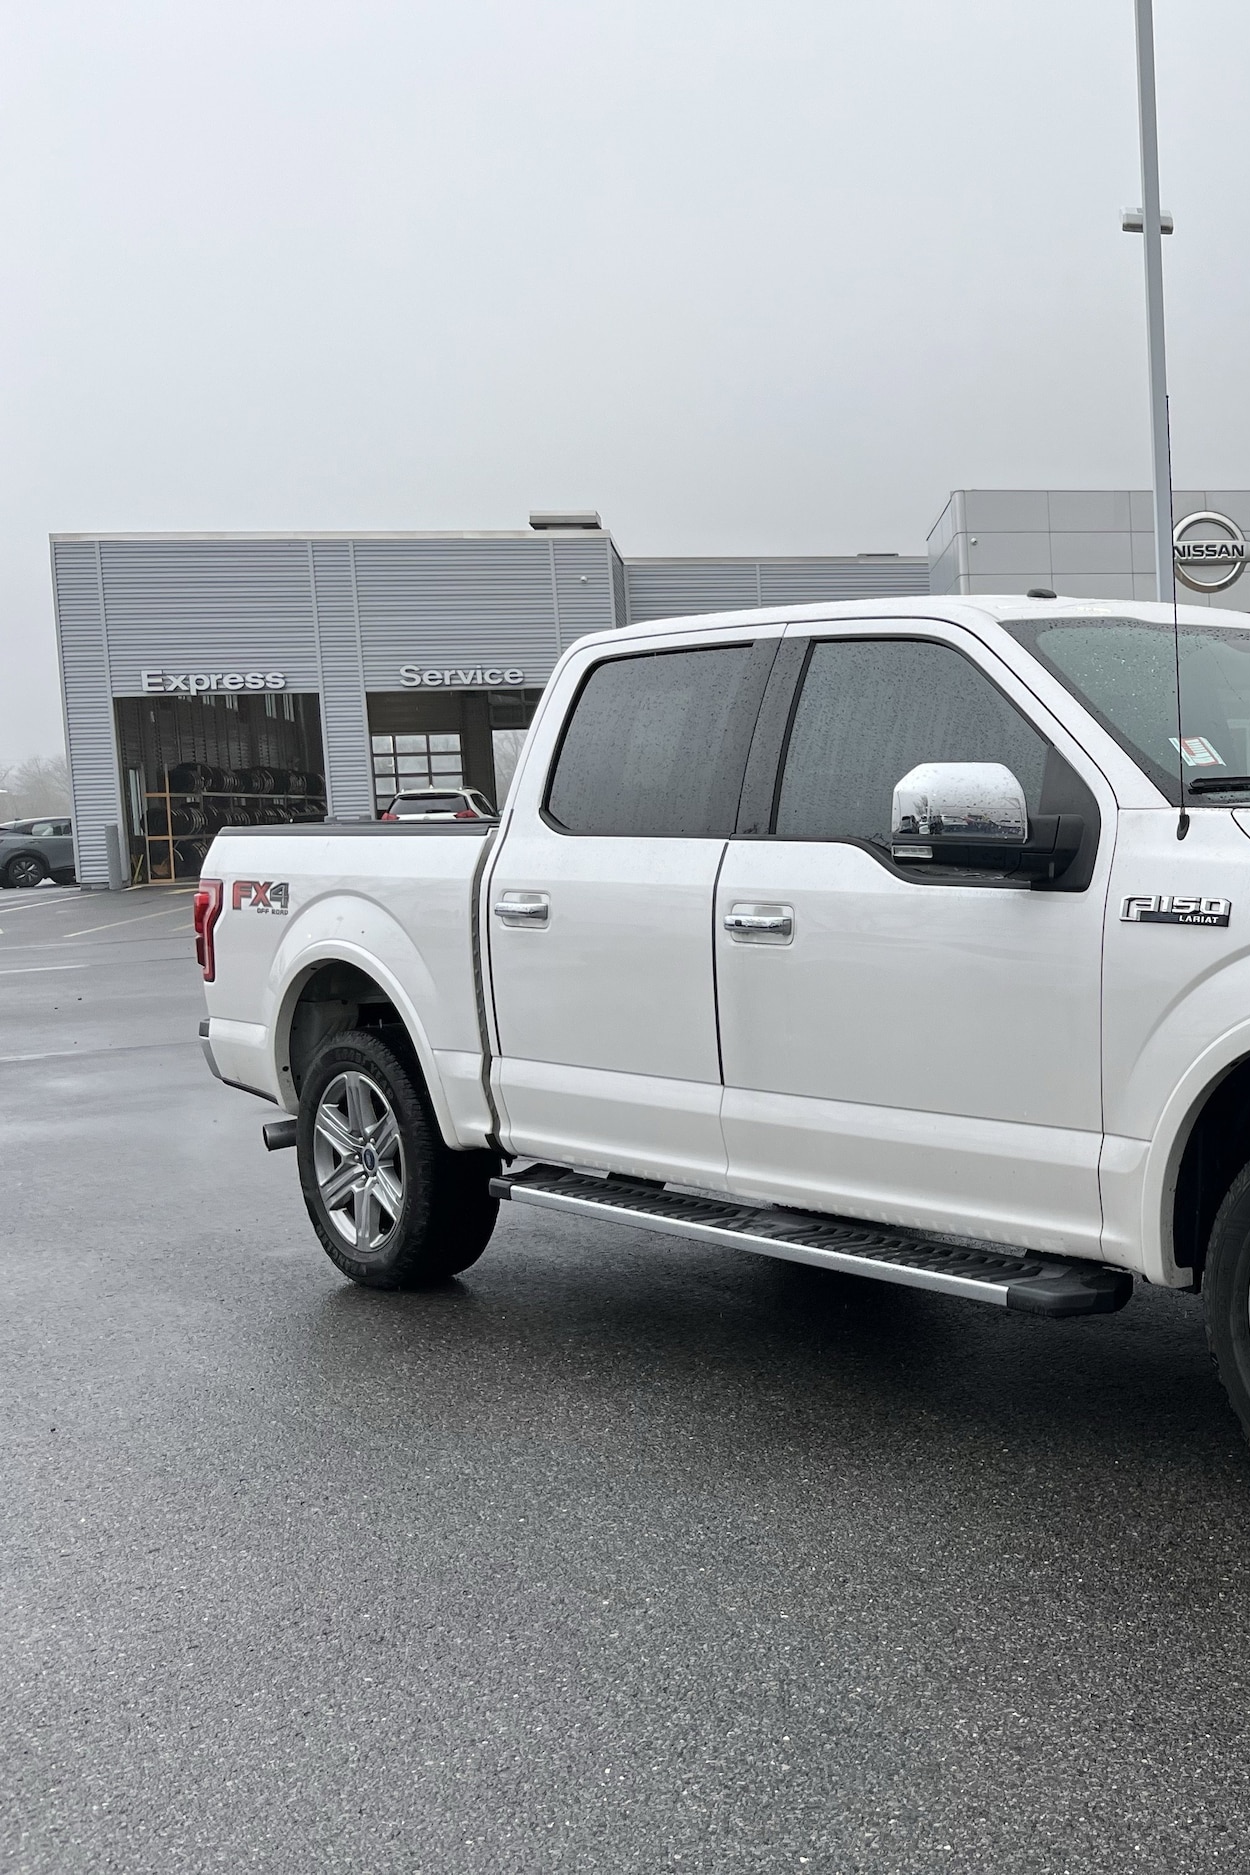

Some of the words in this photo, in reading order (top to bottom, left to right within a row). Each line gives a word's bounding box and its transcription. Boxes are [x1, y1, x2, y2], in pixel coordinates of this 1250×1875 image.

[1173, 544, 1244, 558] NISSAN
[140, 669, 287, 696] Express
[399, 664, 524, 688] Service
[232, 880, 290, 911] FX4
[257, 907, 270, 915] OFF
[271, 908, 289, 916] ROAD
[1179, 914, 1219, 924] LARIAT
